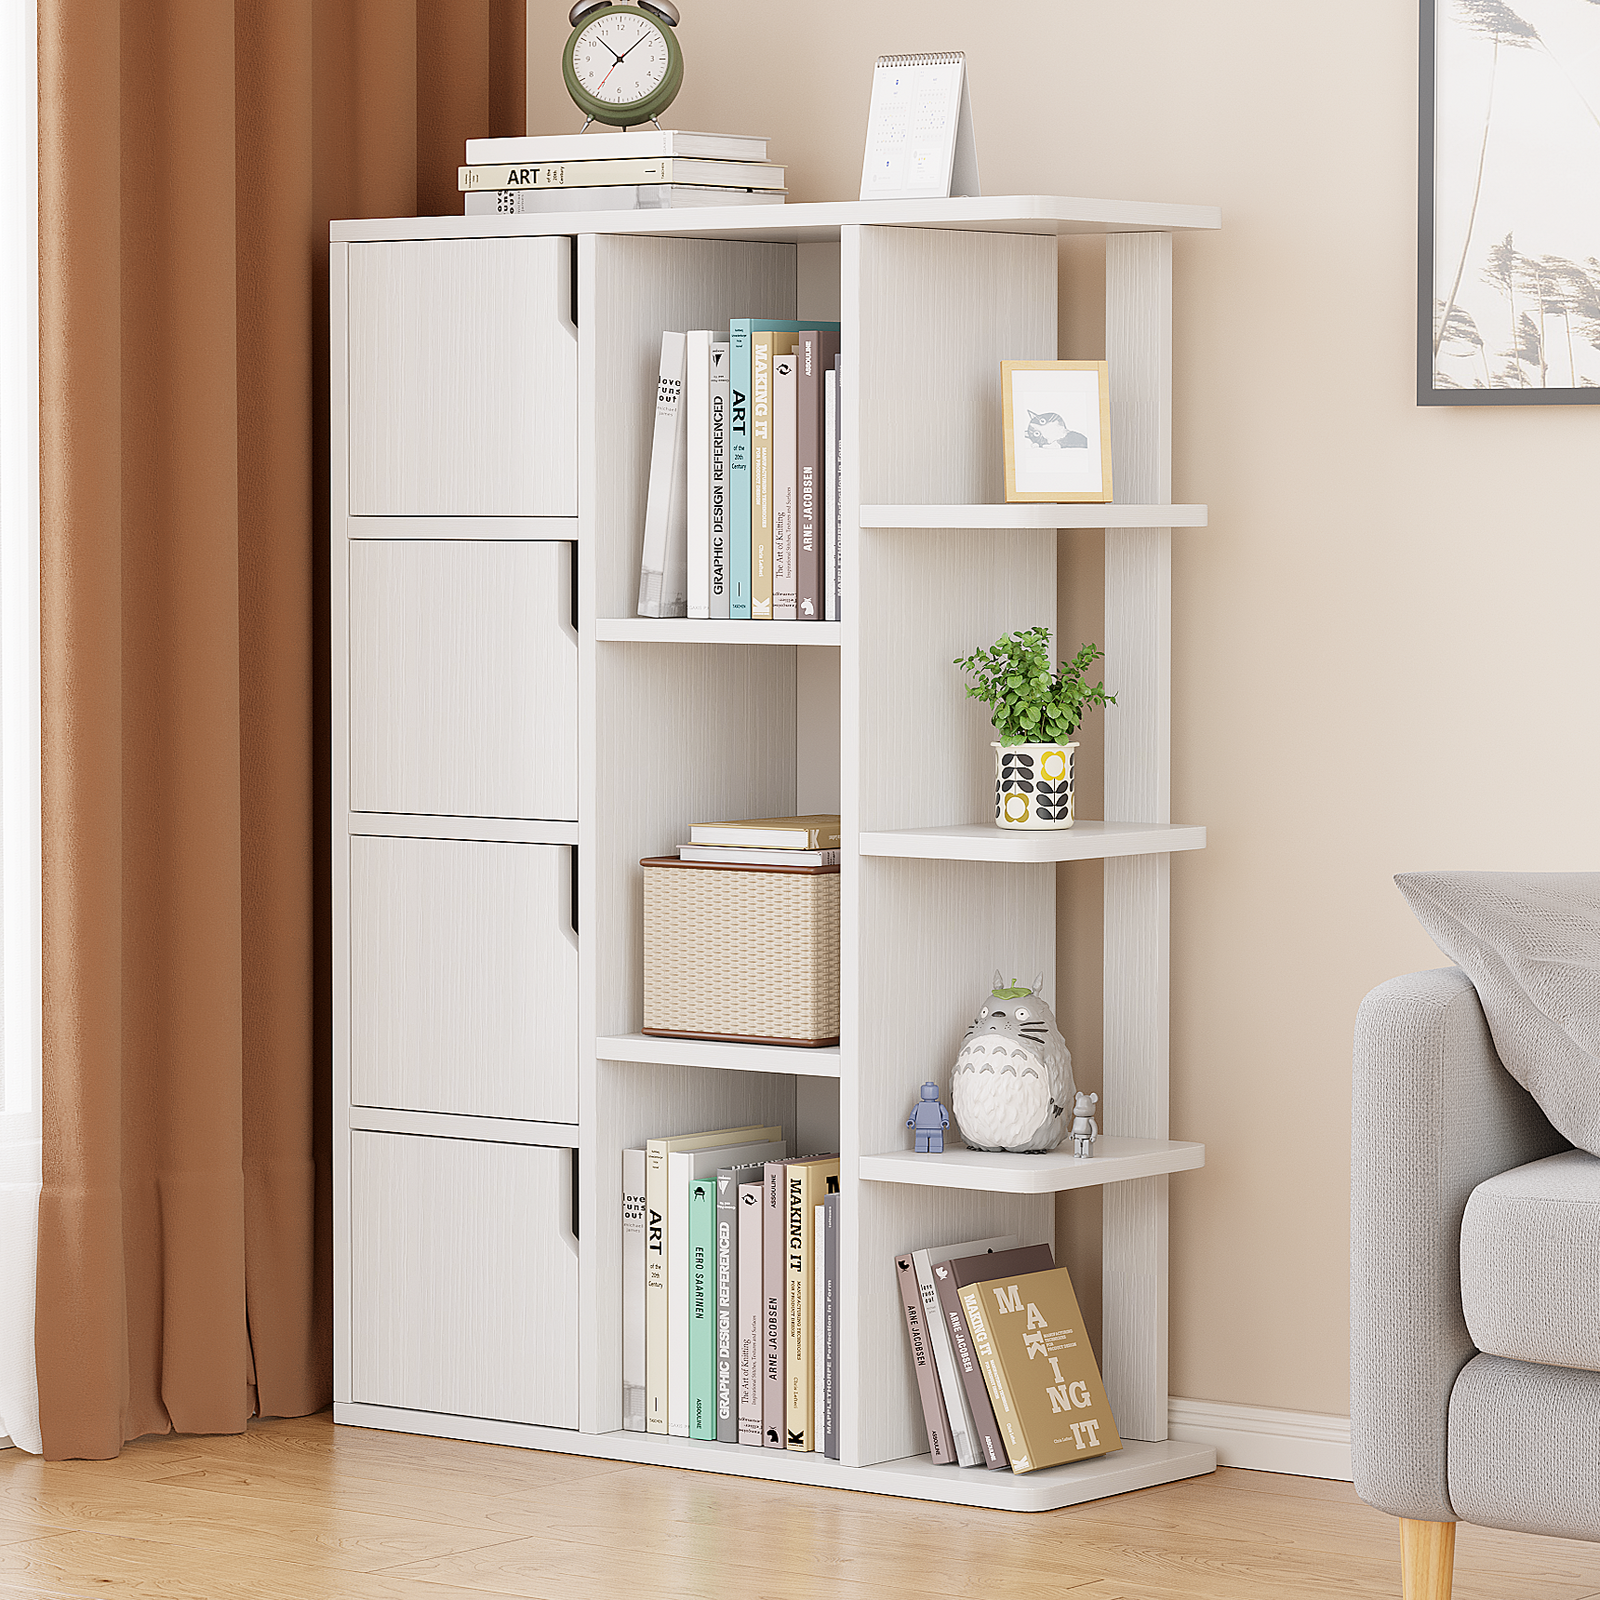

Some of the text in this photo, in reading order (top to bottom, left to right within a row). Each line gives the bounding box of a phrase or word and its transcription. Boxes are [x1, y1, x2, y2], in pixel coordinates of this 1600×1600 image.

[506, 168, 540, 185] ART
[659, 395, 677, 403] out
[756, 344, 768, 440] MAKING IT
[732, 389, 746, 436] ART
[713, 396, 724, 596] GRAPHIC DESIGN REFERENCED
[803, 466, 812, 552] ARNE JACOBSEN
[776, 512, 785, 541] Knitting
[776, 542, 784, 550] of
[622, 1192, 646, 1203] love
[649, 1208, 662, 1256] ART
[790, 1178, 802, 1273] MAKING IT
[648, 1280, 663, 1288] Century
[694, 1246, 704, 1319] EERO SAARINEN
[720, 1222, 730, 1307] REFERENCED
[992, 1284, 1024, 1314] M
[1026, 1302, 1048, 1330] A
[720, 1310, 730, 1358] DESIGN
[768, 1297, 778, 1380] ARNE JACOBSEN
[907, 1305, 926, 1366] ARNE JACOBSEN
[949, 1312, 974, 1373] ARNE JACOBSEN
[964, 1293, 992, 1356] MAKING IT
[742, 1338, 750, 1368] Knitting
[1022, 1330, 1048, 1360] K
[720, 1361, 730, 1420] GRAPHIC
[742, 1368, 749, 1377] of
[1048, 1357, 1064, 1384] I
[1046, 1380, 1092, 1414] NG
[1070, 1418, 1100, 1450] IT
